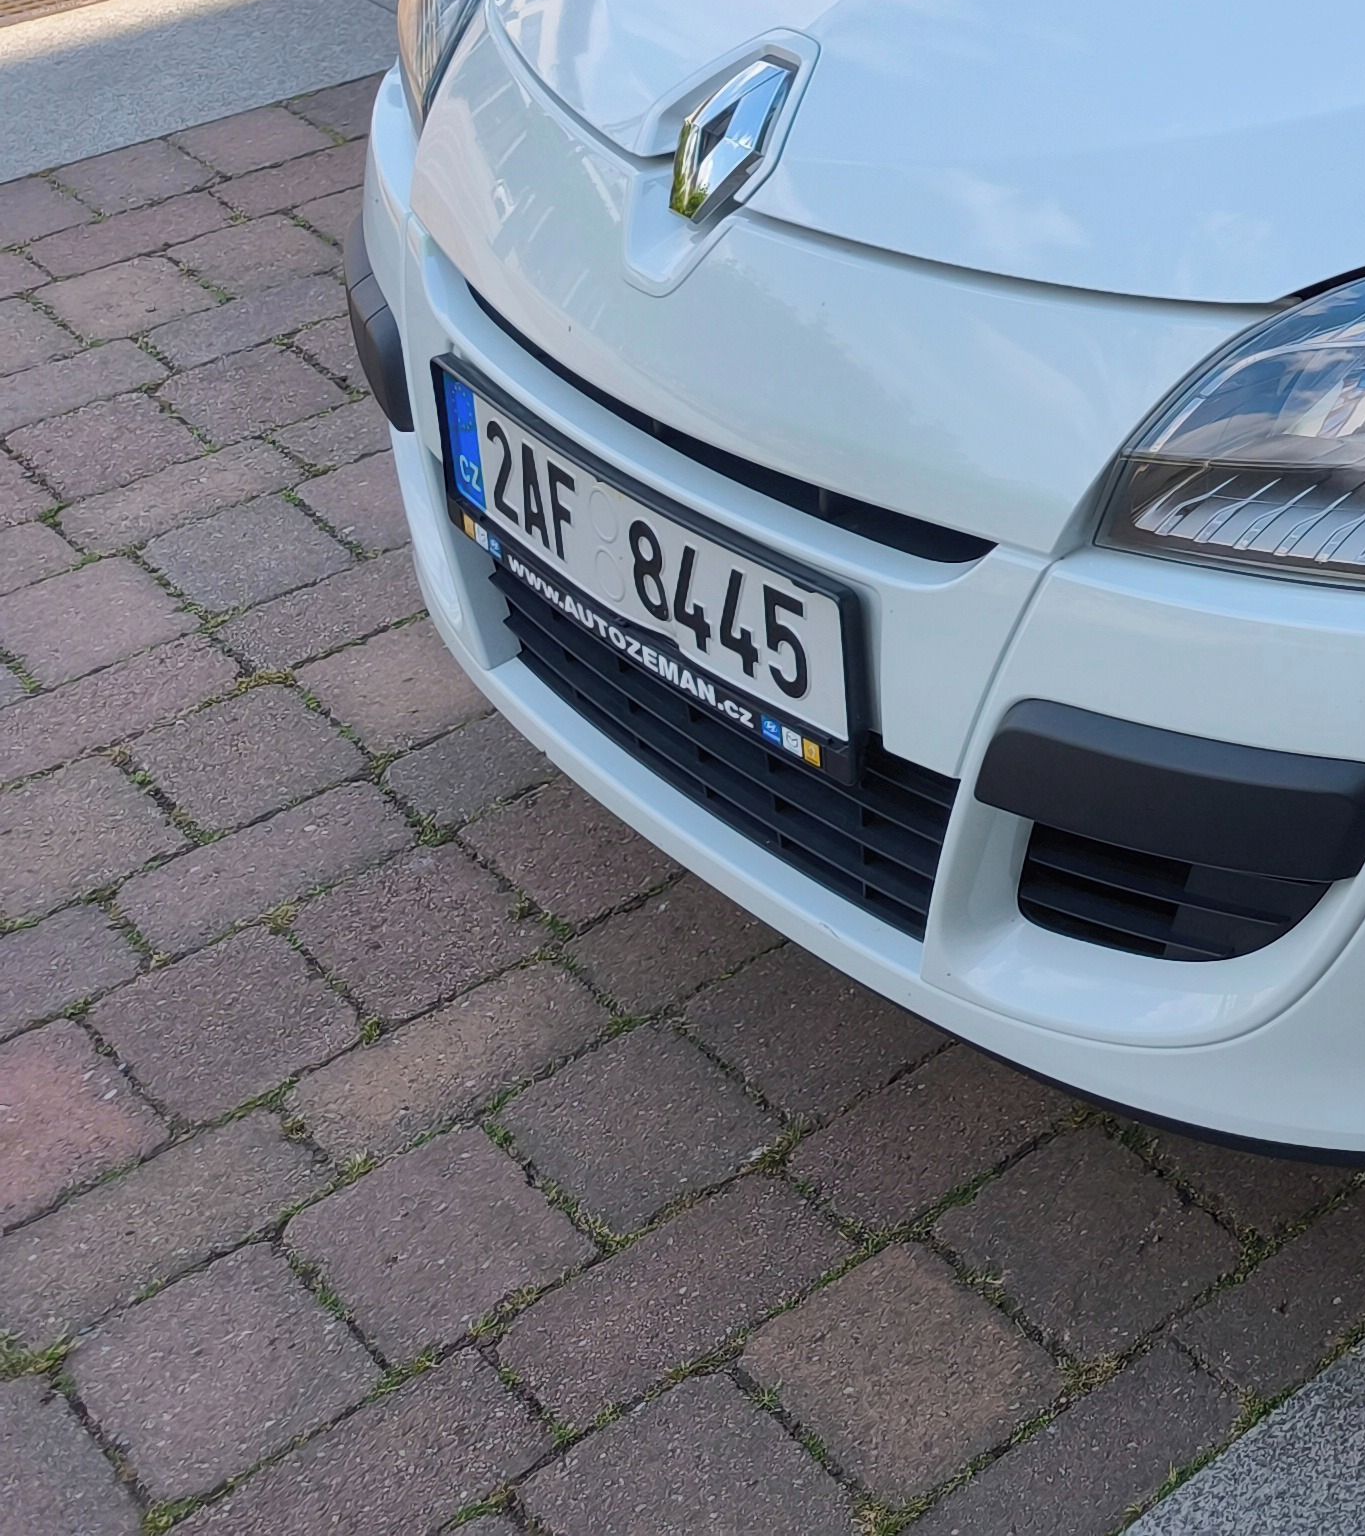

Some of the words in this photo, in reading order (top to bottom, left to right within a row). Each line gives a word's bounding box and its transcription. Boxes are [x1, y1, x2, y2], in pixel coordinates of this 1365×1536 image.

[459, 454, 481, 492] CZ
[487, 419, 575, 560] 2AF
[629, 520, 809, 699] 8445
